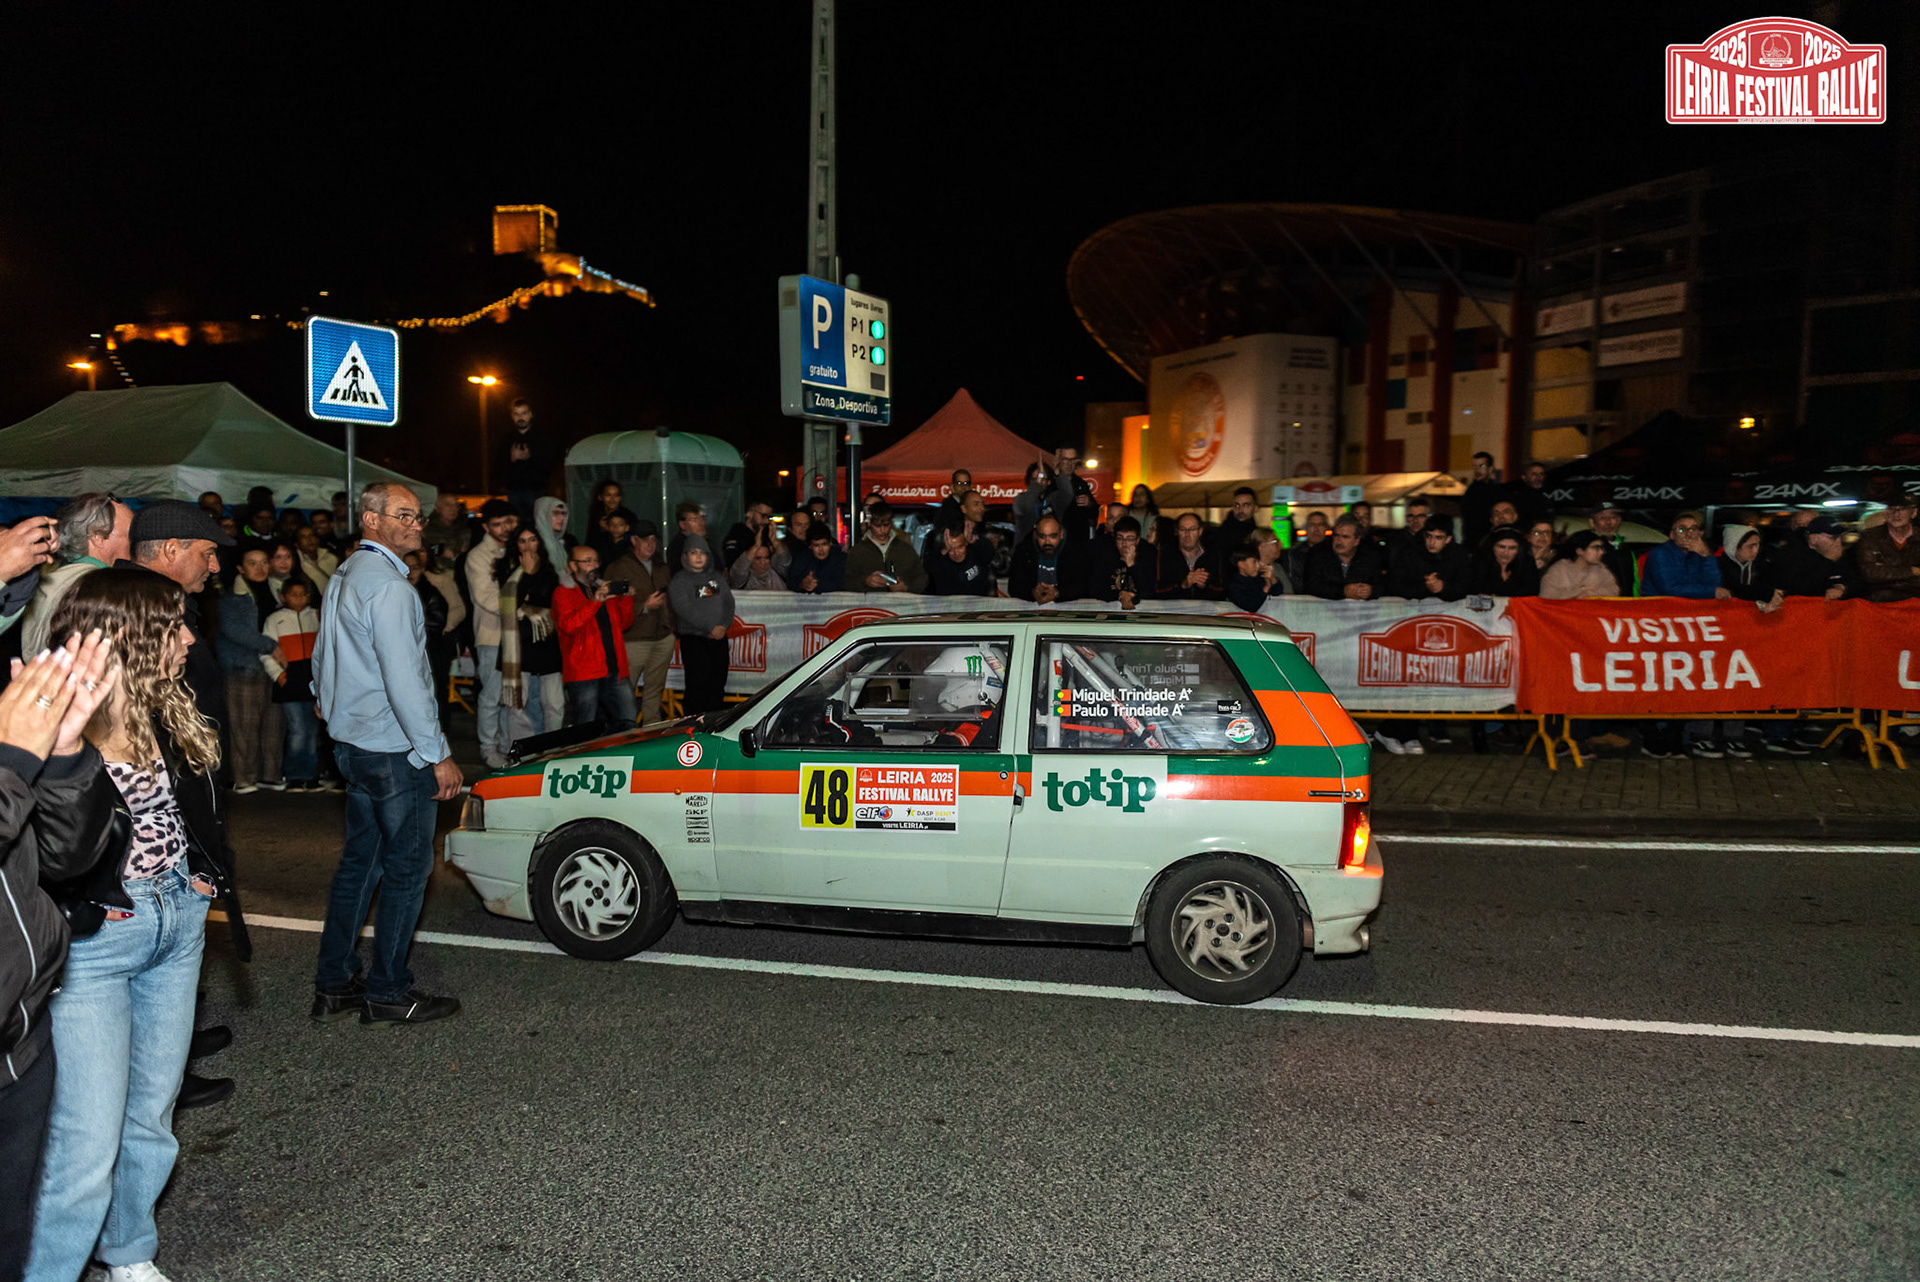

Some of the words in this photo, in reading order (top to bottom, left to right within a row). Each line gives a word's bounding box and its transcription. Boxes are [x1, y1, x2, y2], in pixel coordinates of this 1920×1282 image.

[812, 294, 833, 350] P
[851, 316, 864, 334] P1
[852, 343, 866, 360] P2
[809, 364, 838, 379] gratuito
[814, 393, 836, 409] Zona
[839, 397, 878, 415] Desportiva
[872, 484, 937, 498] Escuderia
[1613, 486, 1685, 501] 24MX
[1753, 482, 1842, 500] 24MX
[1599, 615, 1725, 644] VISITE
[1363, 638, 1402, 683] LEIRIA
[1405, 652, 1461, 684] FESTIVAL
[1464, 640, 1509, 684] RALLYE
[1569, 649, 1763, 693] LEIRIA
[1072, 688, 1117, 705] Miguel
[1119, 688, 1176, 702] Trindade
[1072, 704, 1109, 717] Paulo
[1110, 704, 1168, 717] Trindade
[685, 745, 695, 758] E
[548, 764, 627, 799] totip
[877, 770, 925, 785] LEIRIA
[931, 772, 954, 784] 2025
[804, 769, 849, 826] 48
[858, 786, 911, 802] FESTIVAL
[912, 787, 954, 803] RALLYE
[1042, 767, 1157, 813] totip
[855, 807, 880, 820] elf
